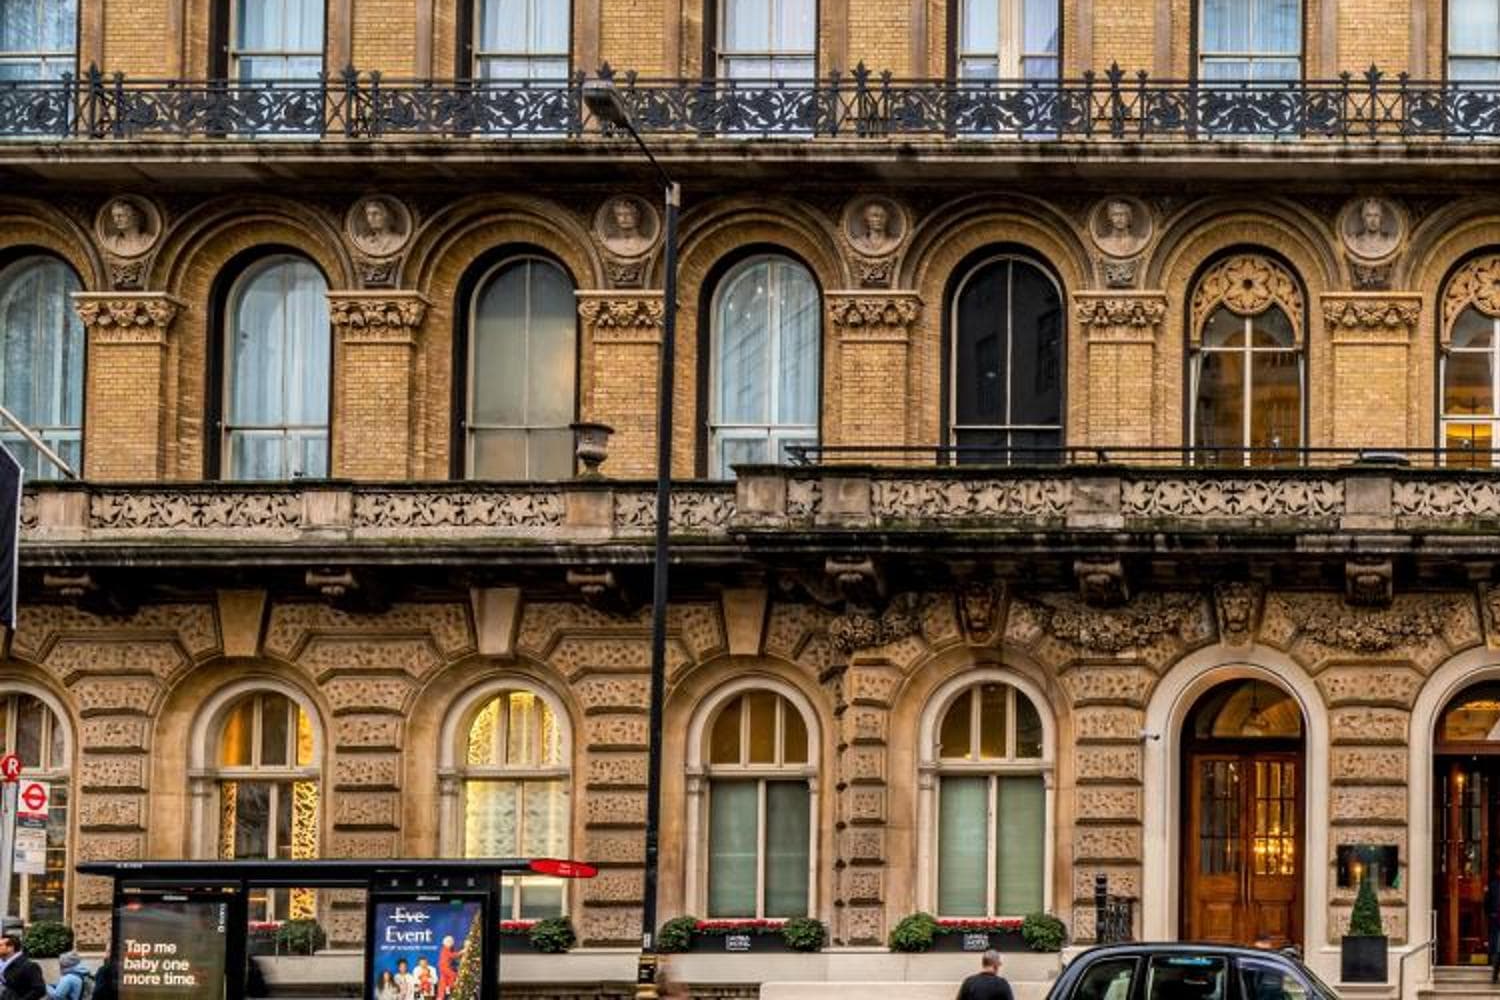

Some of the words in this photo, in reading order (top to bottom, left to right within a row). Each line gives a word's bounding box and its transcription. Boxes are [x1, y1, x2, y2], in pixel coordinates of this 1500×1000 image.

[7, 757, 18, 774] R
[385, 925, 432, 943] Event
[125, 939, 151, 957] Tap
[154, 943, 177, 954] me
[124, 957, 159, 972] baby
[162, 960, 190, 971] one
[123, 974, 161, 985] more
